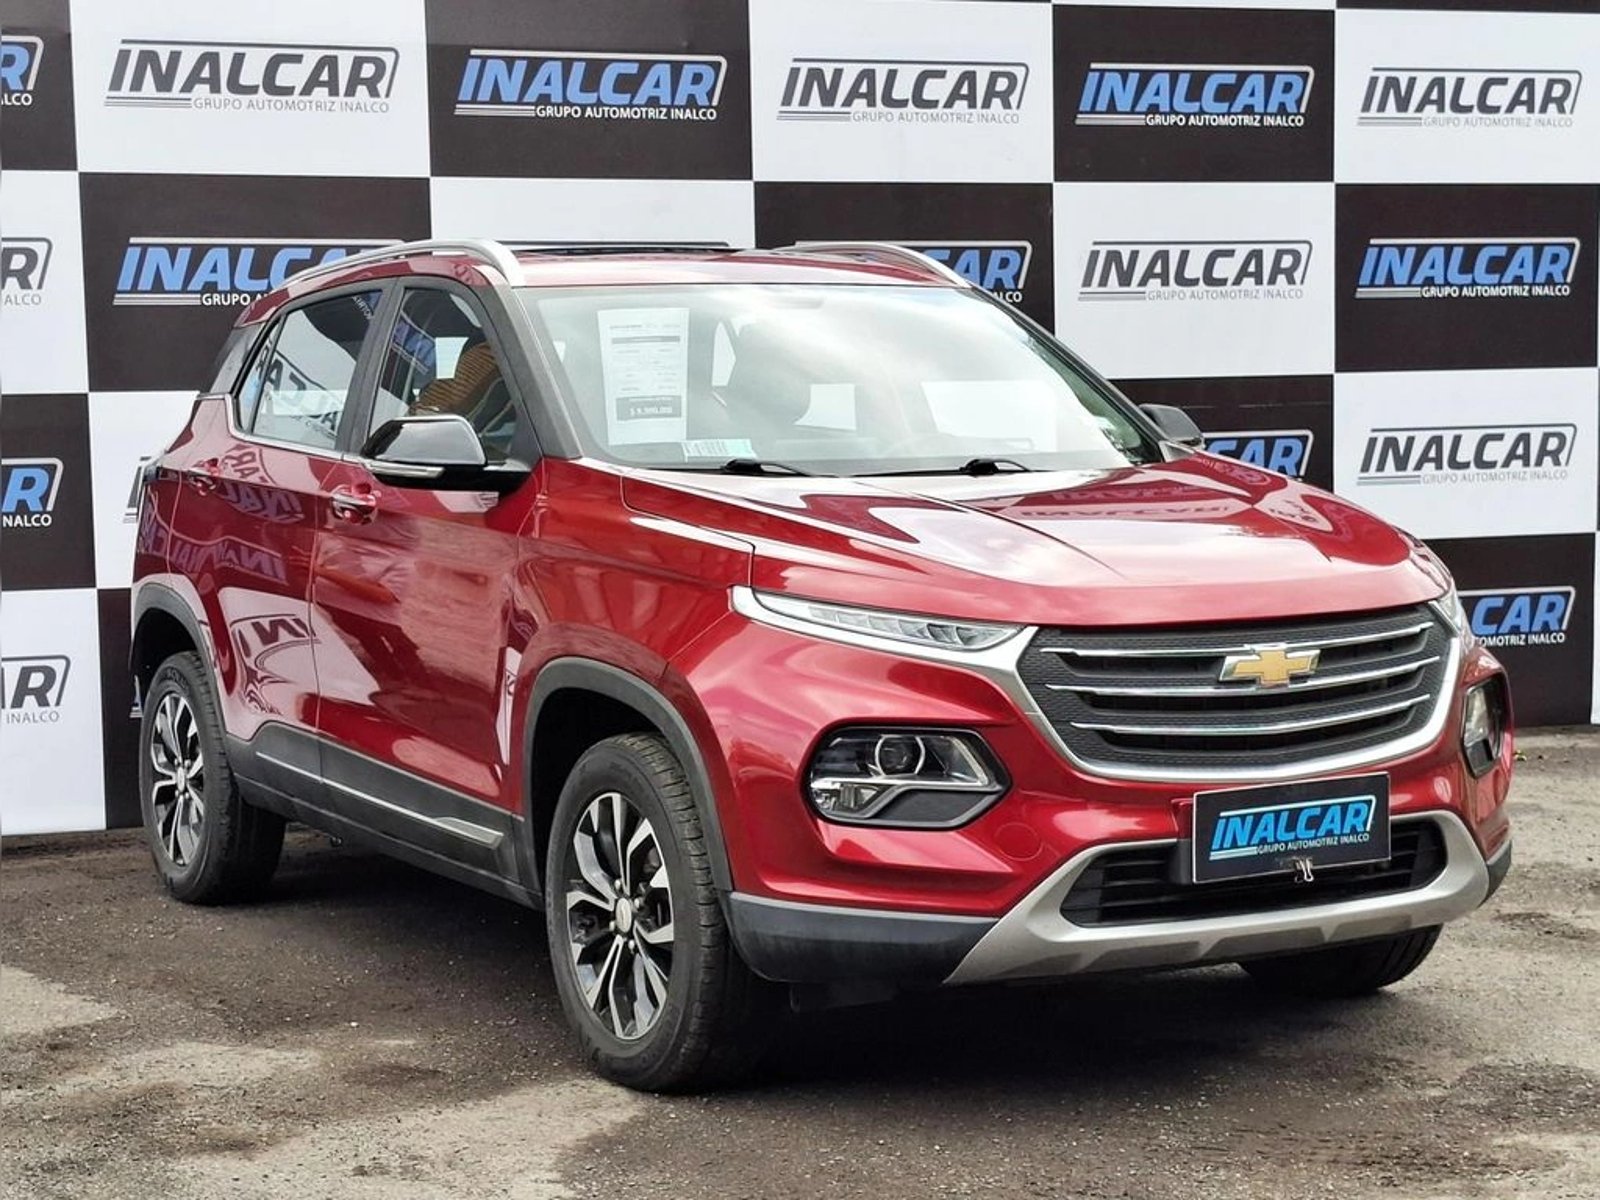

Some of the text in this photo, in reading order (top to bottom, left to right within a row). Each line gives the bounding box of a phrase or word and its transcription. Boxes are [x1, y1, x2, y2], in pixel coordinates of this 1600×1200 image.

[108, 49, 387, 98] INALCAR
[457, 58, 715, 106] INALCAR
[780, 67, 1018, 110] INALCAR
[1079, 71, 1304, 114] INALCAR
[1360, 76, 1572, 115] INALCAR
[193, 99, 389, 114] GRUPO AUTOMOTRIZ INALCO
[536, 105, 716, 120] GRUPO AUTOMOTRIZ INALCO
[852, 111, 1020, 124] GRUPO AUTOMOTRIZ INALCO
[1146, 114, 1304, 127] GRUPO AUTOMOTRIZ INALCO
[1424, 117, 1573, 128] GRUPO AUTOMOTRIZ INALCO
[116, 246, 390, 292] INALC
[1081, 248, 1303, 288] INALCAR
[1358, 246, 1570, 286] INALCAR
[202, 293, 250, 306] GRUPO
[1147, 288, 1303, 301] GRUPO AUTOMOTRIZ INALCO
[1422, 284, 1570, 298] GRUPO AUTOMOTRIZ INALCO
[1360, 432, 1567, 473] INALCAR
[1422, 469, 1568, 485] GRUPO AUTOMOTRIZ INALCO
[1528, 632, 1566, 644] INALCO
[6, 710, 60, 724] INALCO
[1212, 802, 1369, 850] INALCAR
[1257, 832, 1370, 855] GRUPO AUTOMOTRIZ INALCO
